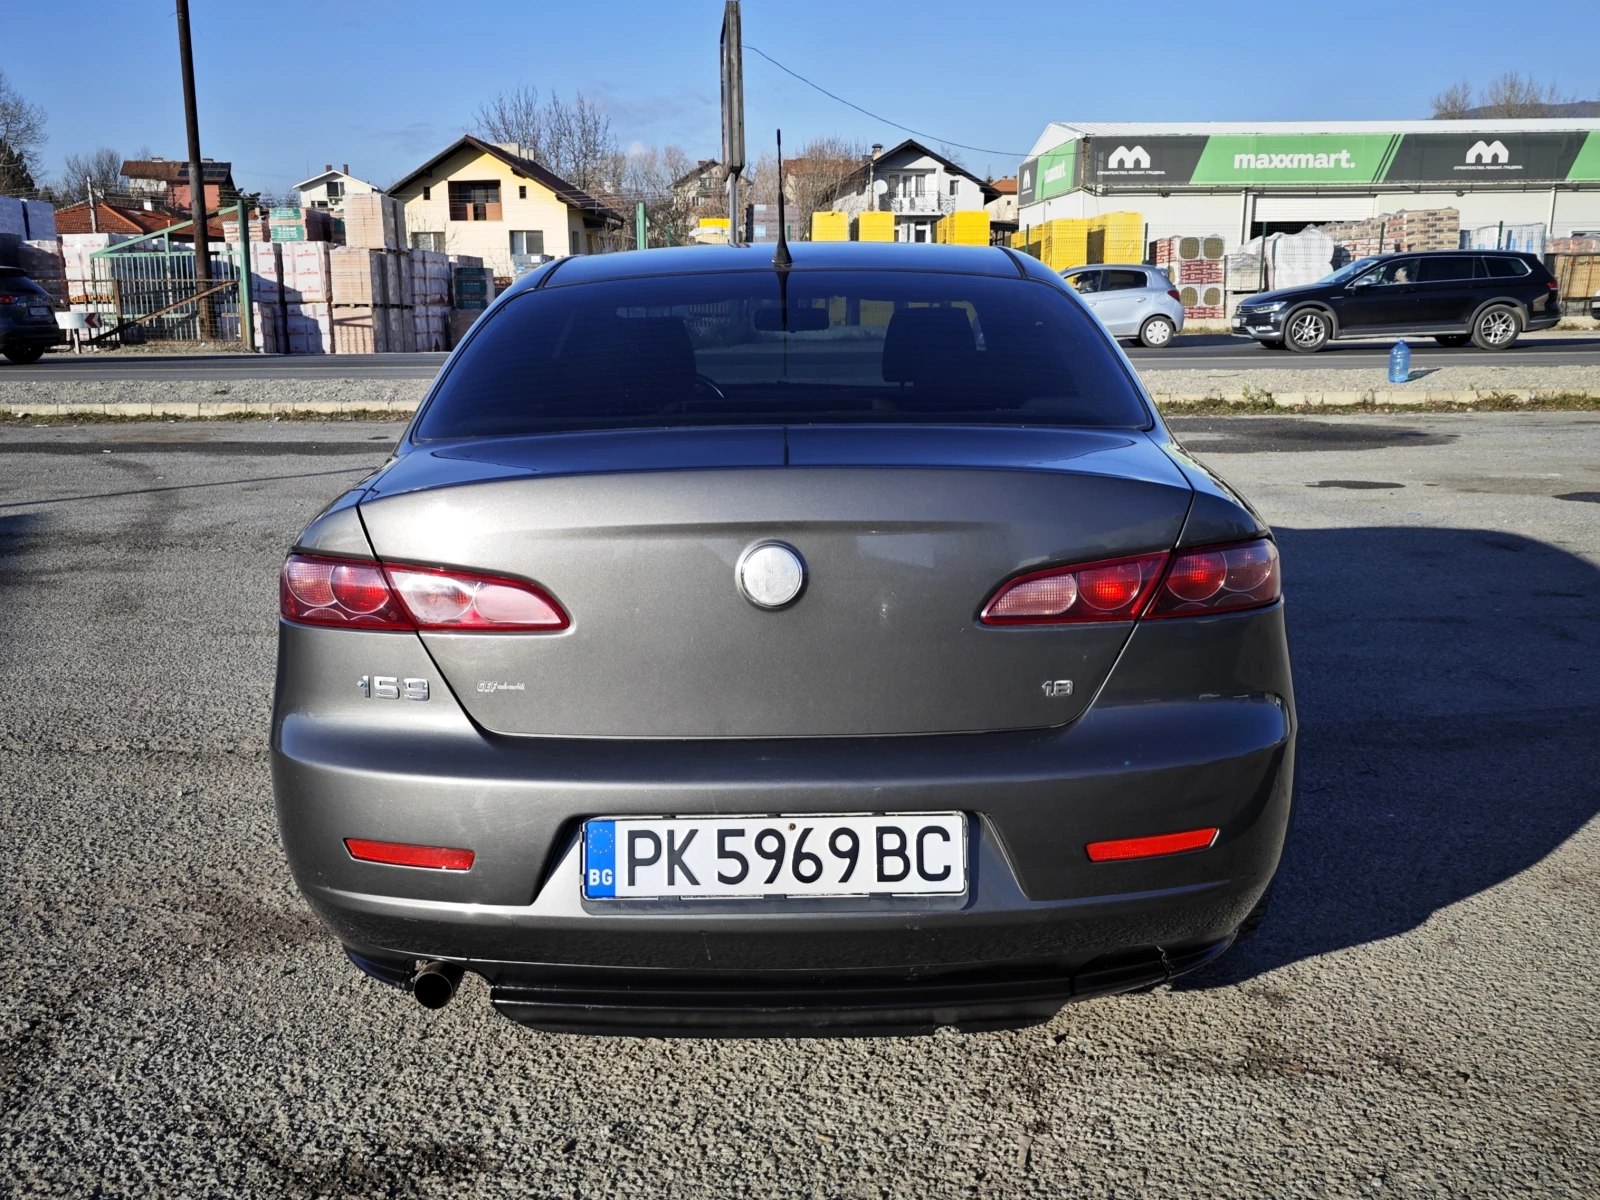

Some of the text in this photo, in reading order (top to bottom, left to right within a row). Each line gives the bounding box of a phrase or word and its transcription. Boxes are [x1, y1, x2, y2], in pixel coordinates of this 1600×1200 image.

[1233, 149, 1356, 169] maxxmart.
[357, 675, 430, 701] 159
[627, 825, 952, 887] PK 5969 BC
[588, 868, 613, 886] BG
